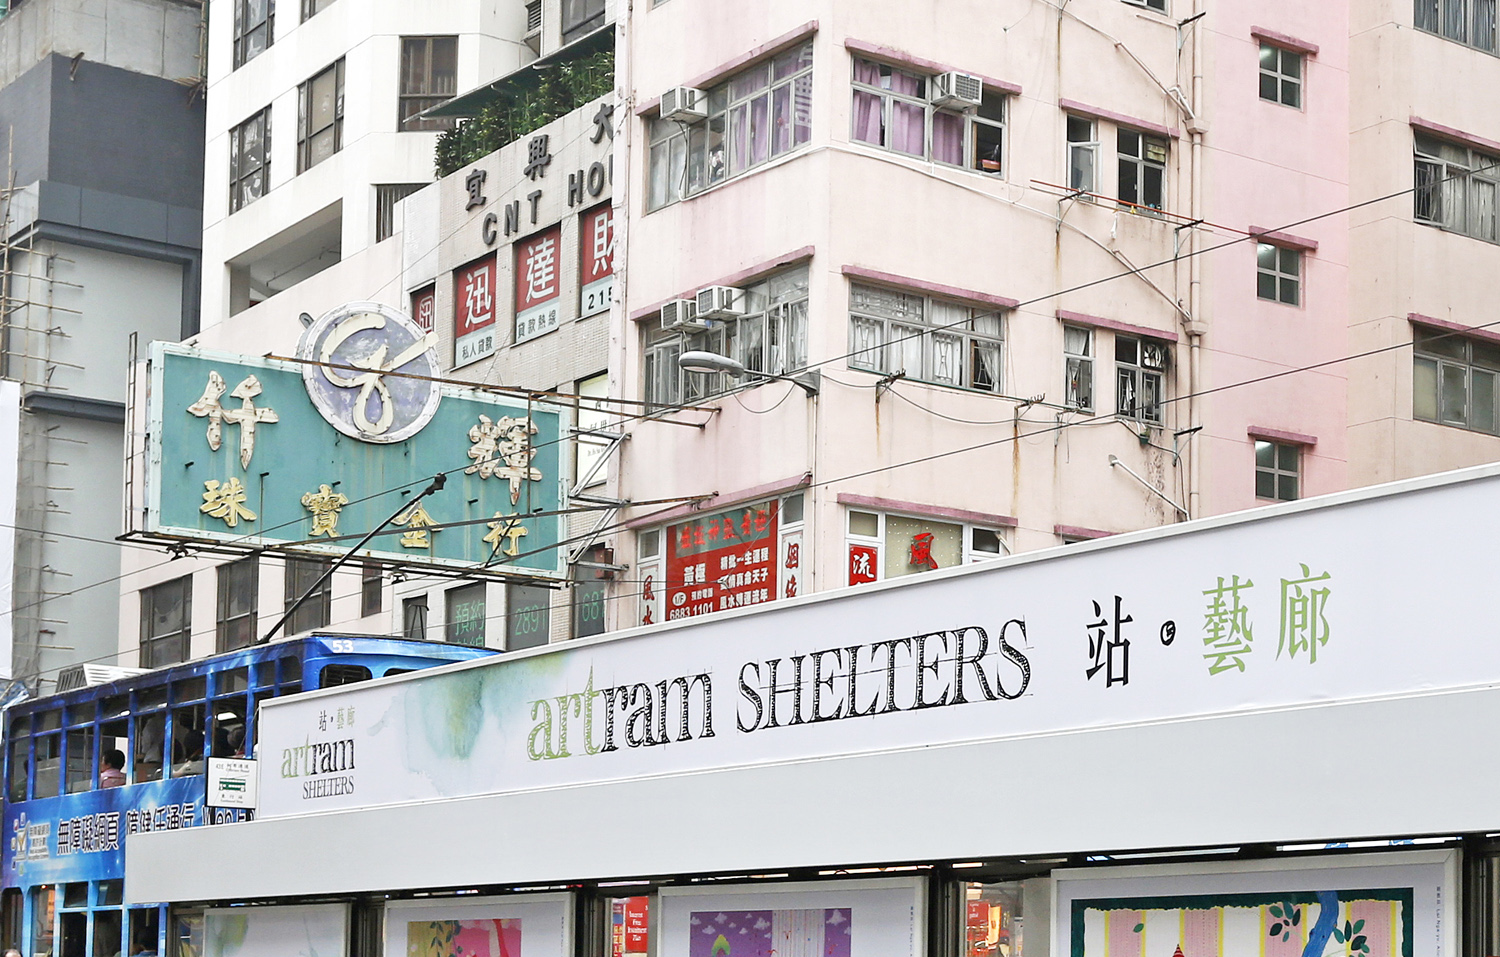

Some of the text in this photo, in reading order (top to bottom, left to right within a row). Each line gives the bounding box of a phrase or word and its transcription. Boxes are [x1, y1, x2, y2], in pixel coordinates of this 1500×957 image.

[482, 189, 542, 246] CNT
[852, 552, 875, 584] 流
[692, 601, 714, 617] 1101
[1201, 563, 1332, 676] 藝廊
[331, 639, 354, 654] 53
[527, 618, 1033, 762] artram SHELTERS
[281, 733, 356, 779] artram
[303, 775, 355, 800] SHELTERS
